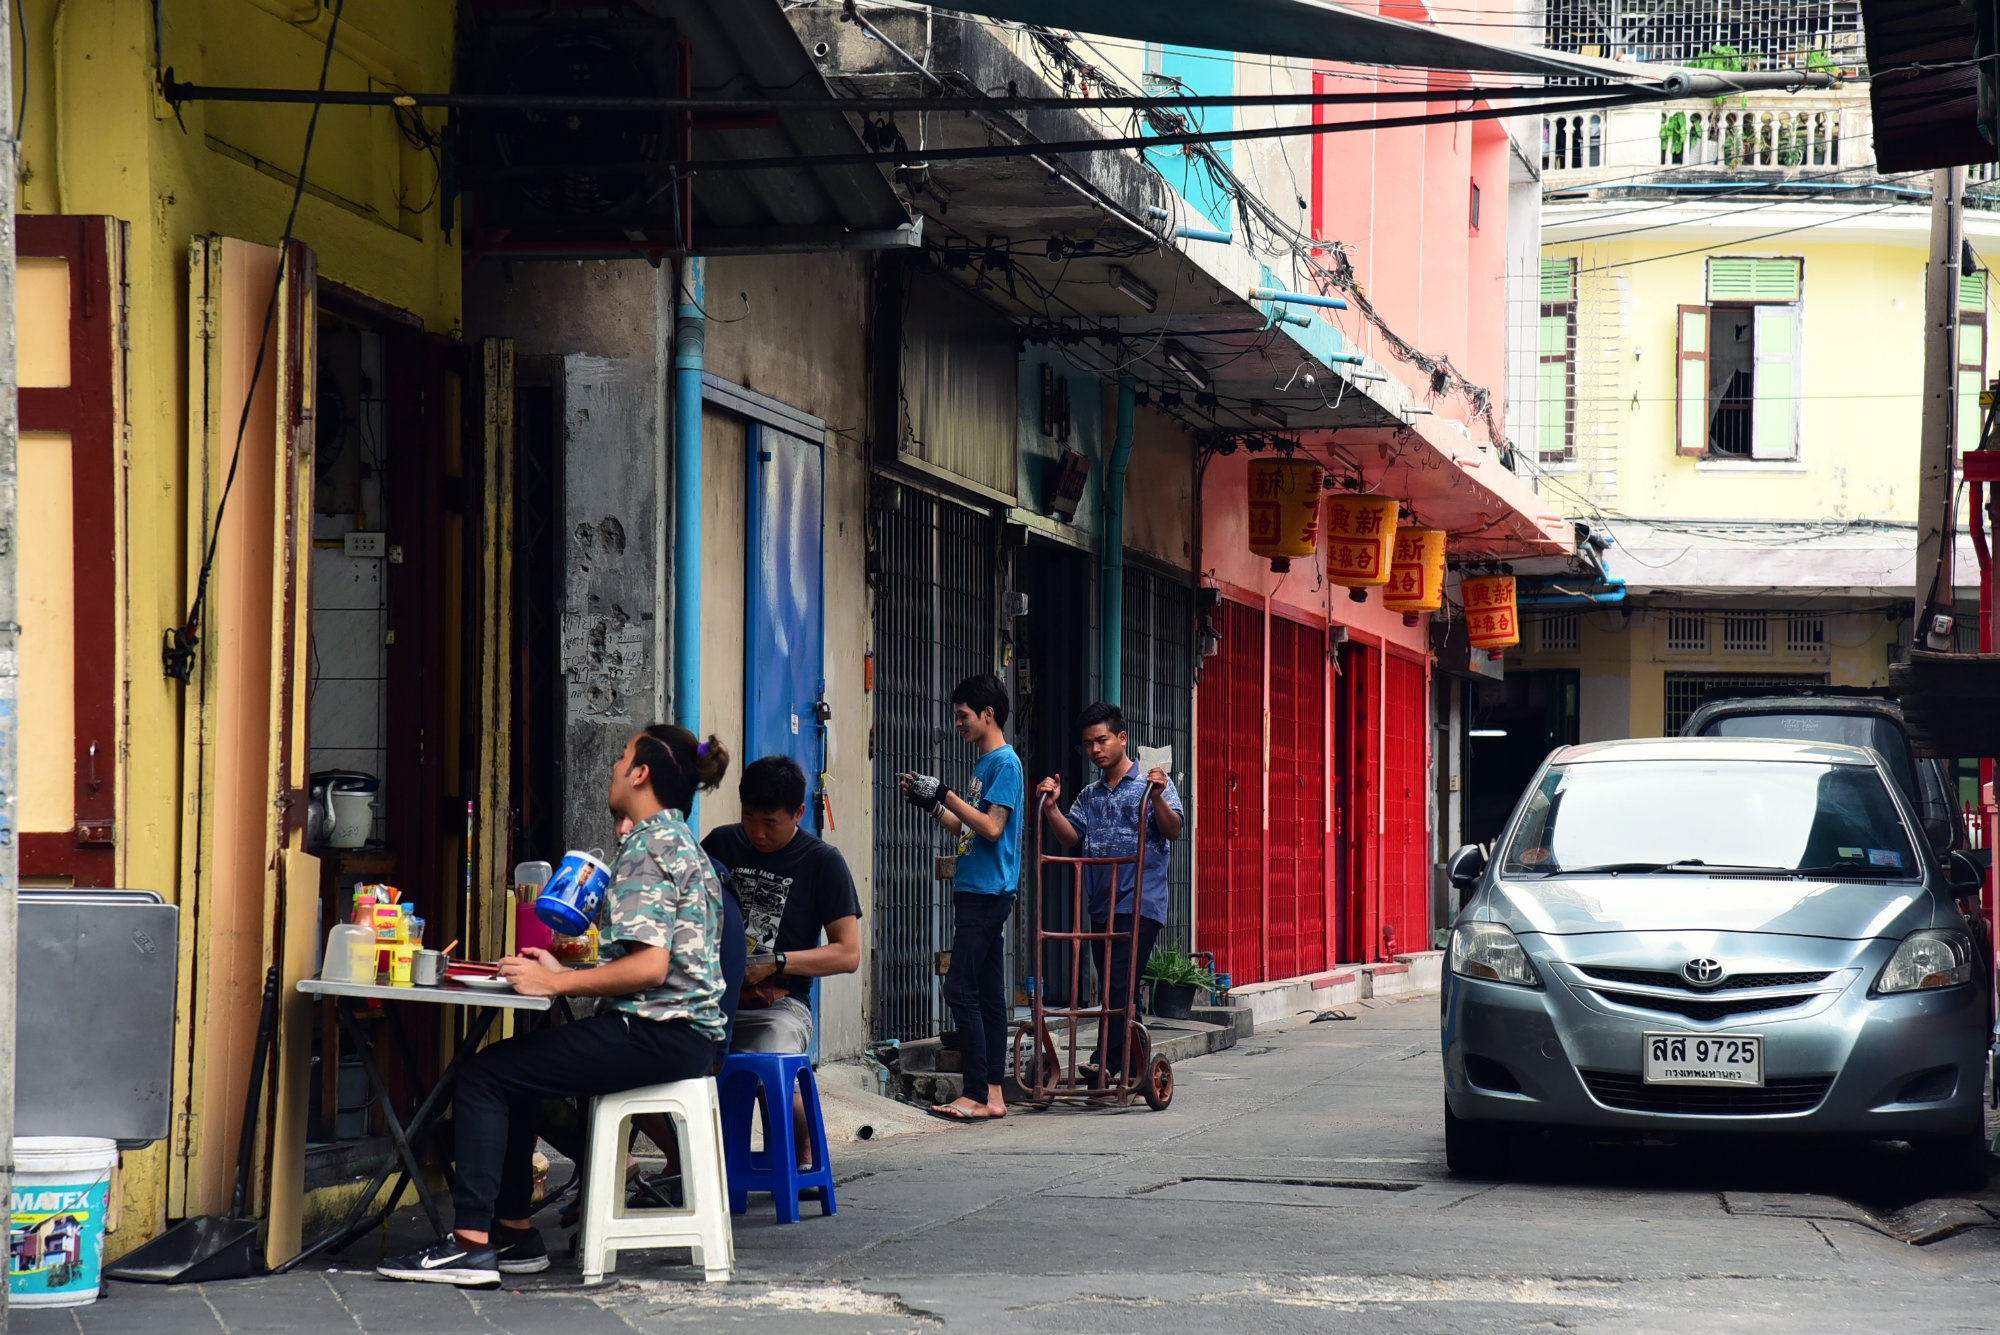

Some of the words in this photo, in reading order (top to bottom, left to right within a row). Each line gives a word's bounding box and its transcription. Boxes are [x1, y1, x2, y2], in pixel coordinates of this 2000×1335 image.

[1249, 469, 1281, 498] 新
[1393, 535, 1425, 561] 新
[1652, 1038, 1686, 1062] สส
[1696, 1040, 1755, 1063] 9725
[1665, 1069, 1742, 1079] กรงเทพมหานคร
